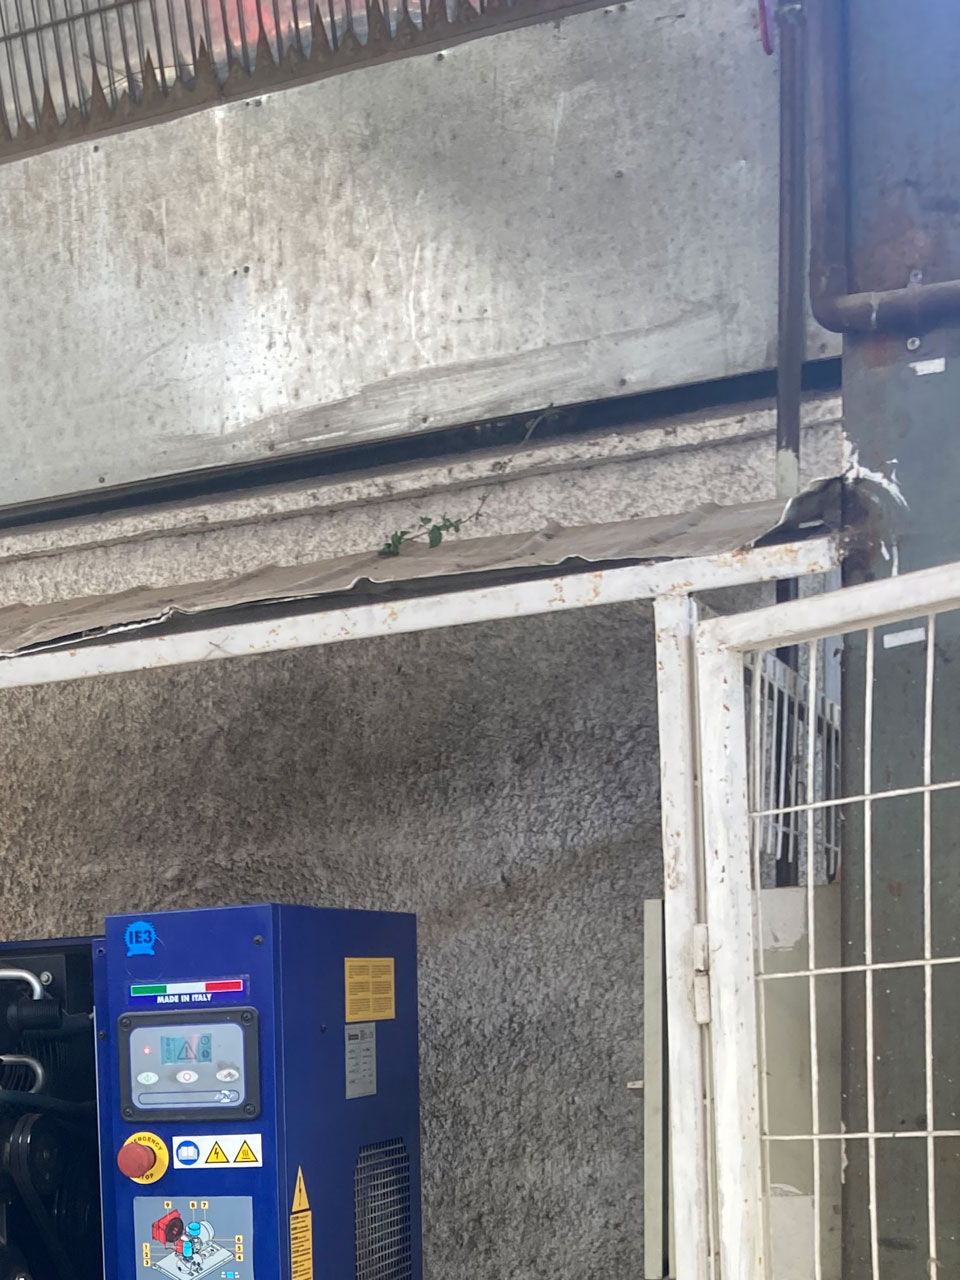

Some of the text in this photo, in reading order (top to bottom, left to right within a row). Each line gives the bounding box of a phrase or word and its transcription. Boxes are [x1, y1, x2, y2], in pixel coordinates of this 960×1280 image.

[129, 930, 152, 944] IE3
[157, 994, 212, 1004] MADE IN ITALY
